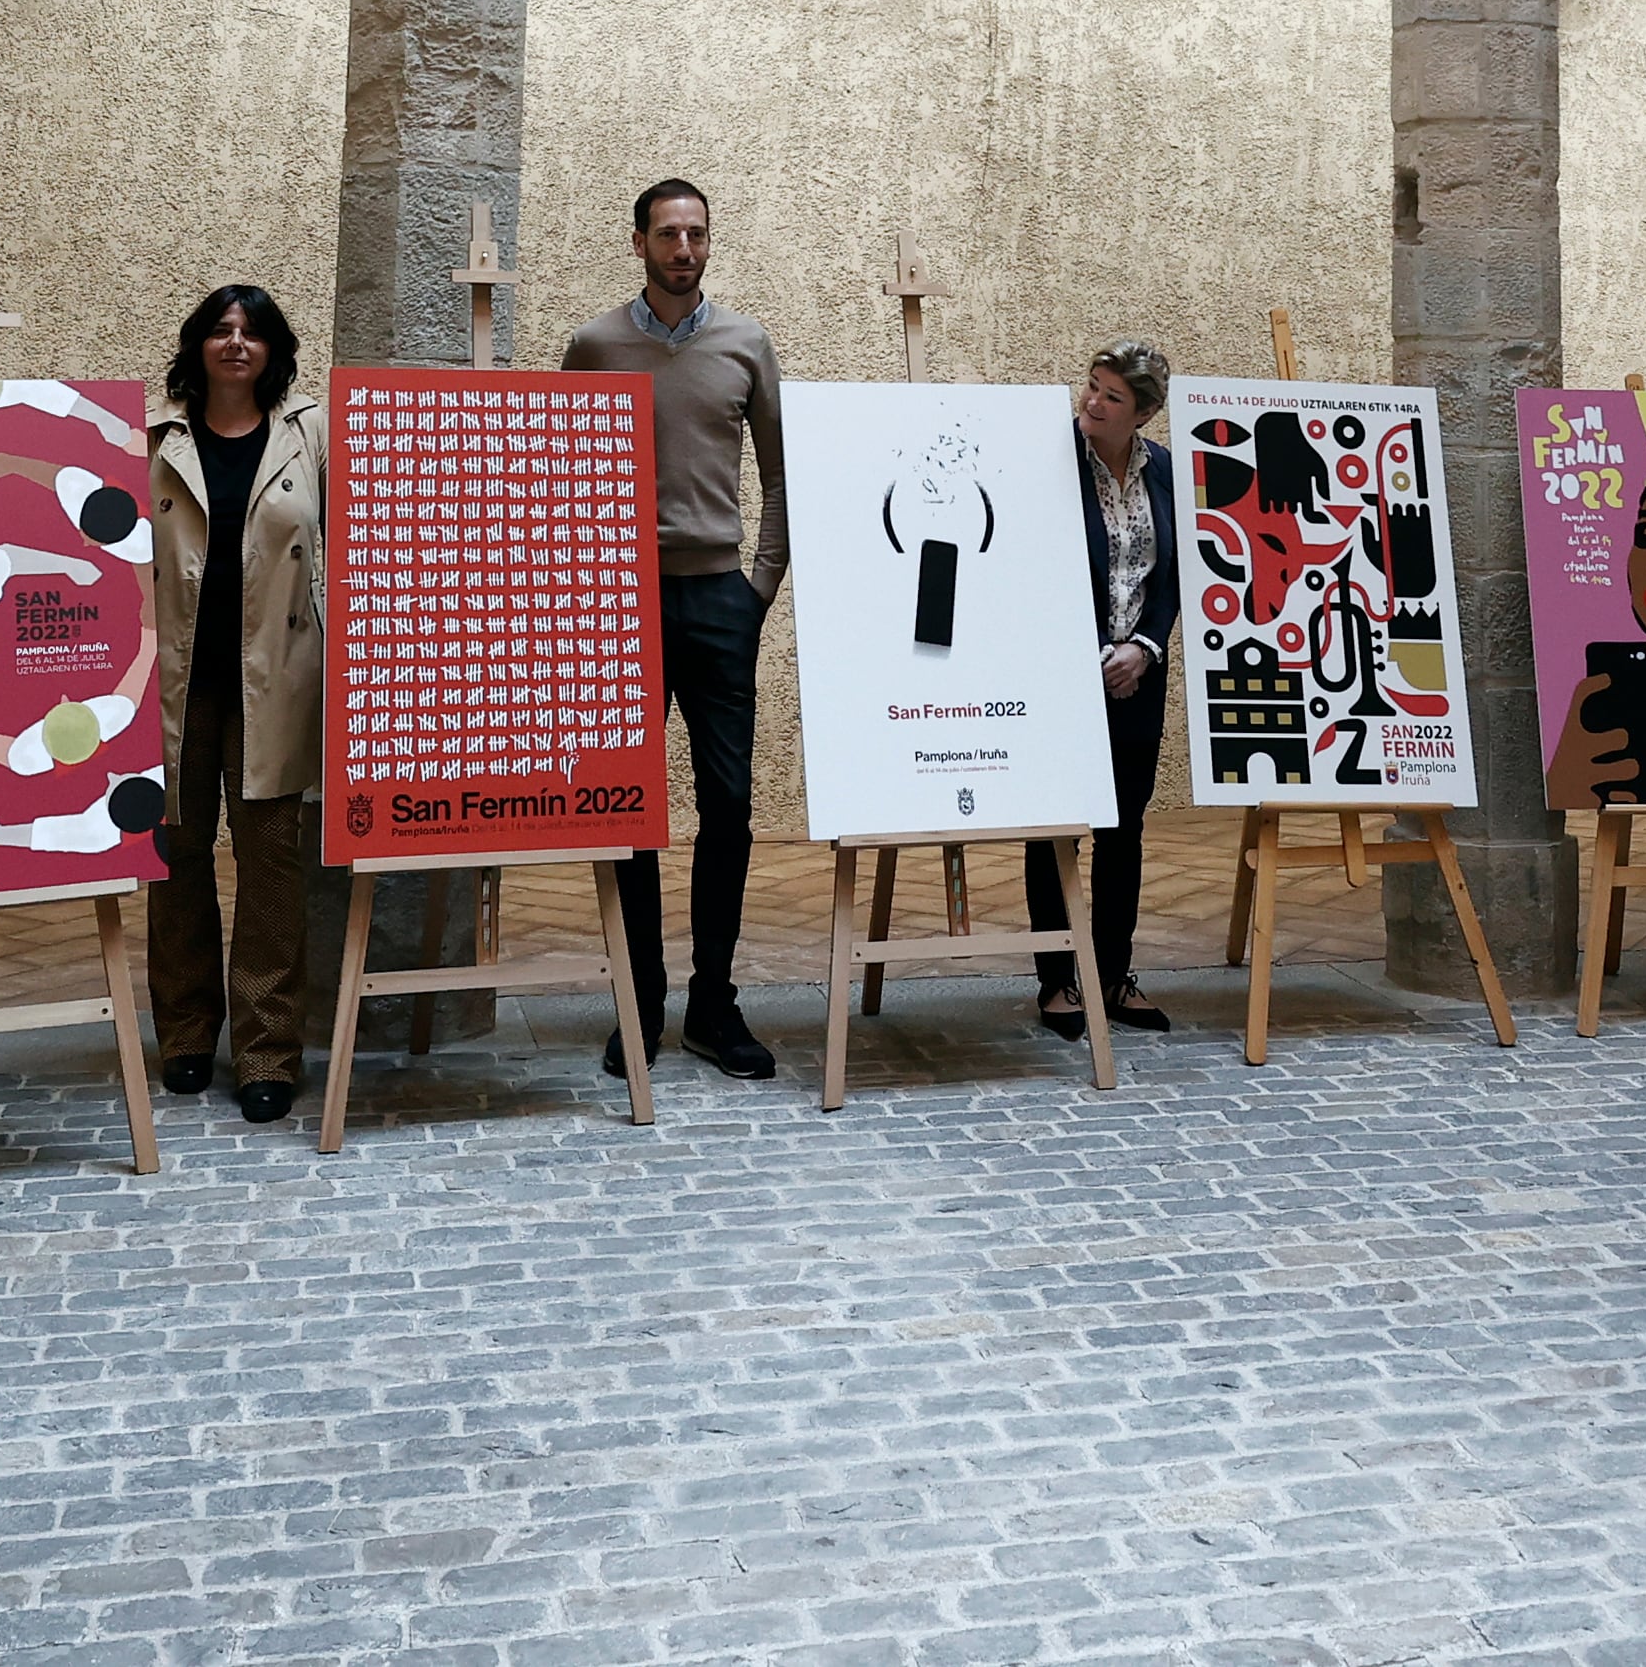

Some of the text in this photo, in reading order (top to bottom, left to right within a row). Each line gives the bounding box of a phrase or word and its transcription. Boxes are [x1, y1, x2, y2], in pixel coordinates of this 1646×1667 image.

[1188, 393, 1421, 414] DEL 6 AL 14 DE JULIO UZTAILAREN 6TIK 14RA
[1541, 467, 1624, 510] 2022
[15, 591, 61, 608] SAN
[16, 602, 99, 624] FERMÍN
[16, 625, 70, 642] 2022
[16, 645, 70, 656] PAMPLONA
[79, 641, 110, 653] IRUÑA
[16, 653, 106, 666] DEL 6 AL 14 DE JULIO
[16, 662, 114, 675] UZTAILAREN 6TIK 14RA
[887, 701, 1027, 720] San Fermín 2022
[915, 750, 973, 764] Pamplona
[980, 748, 1008, 760] Iruña
[1400, 761, 1457, 775] Pamplona
[1401, 774, 1431, 786] Iruña
[391, 786, 645, 823] San Fermín 2022
